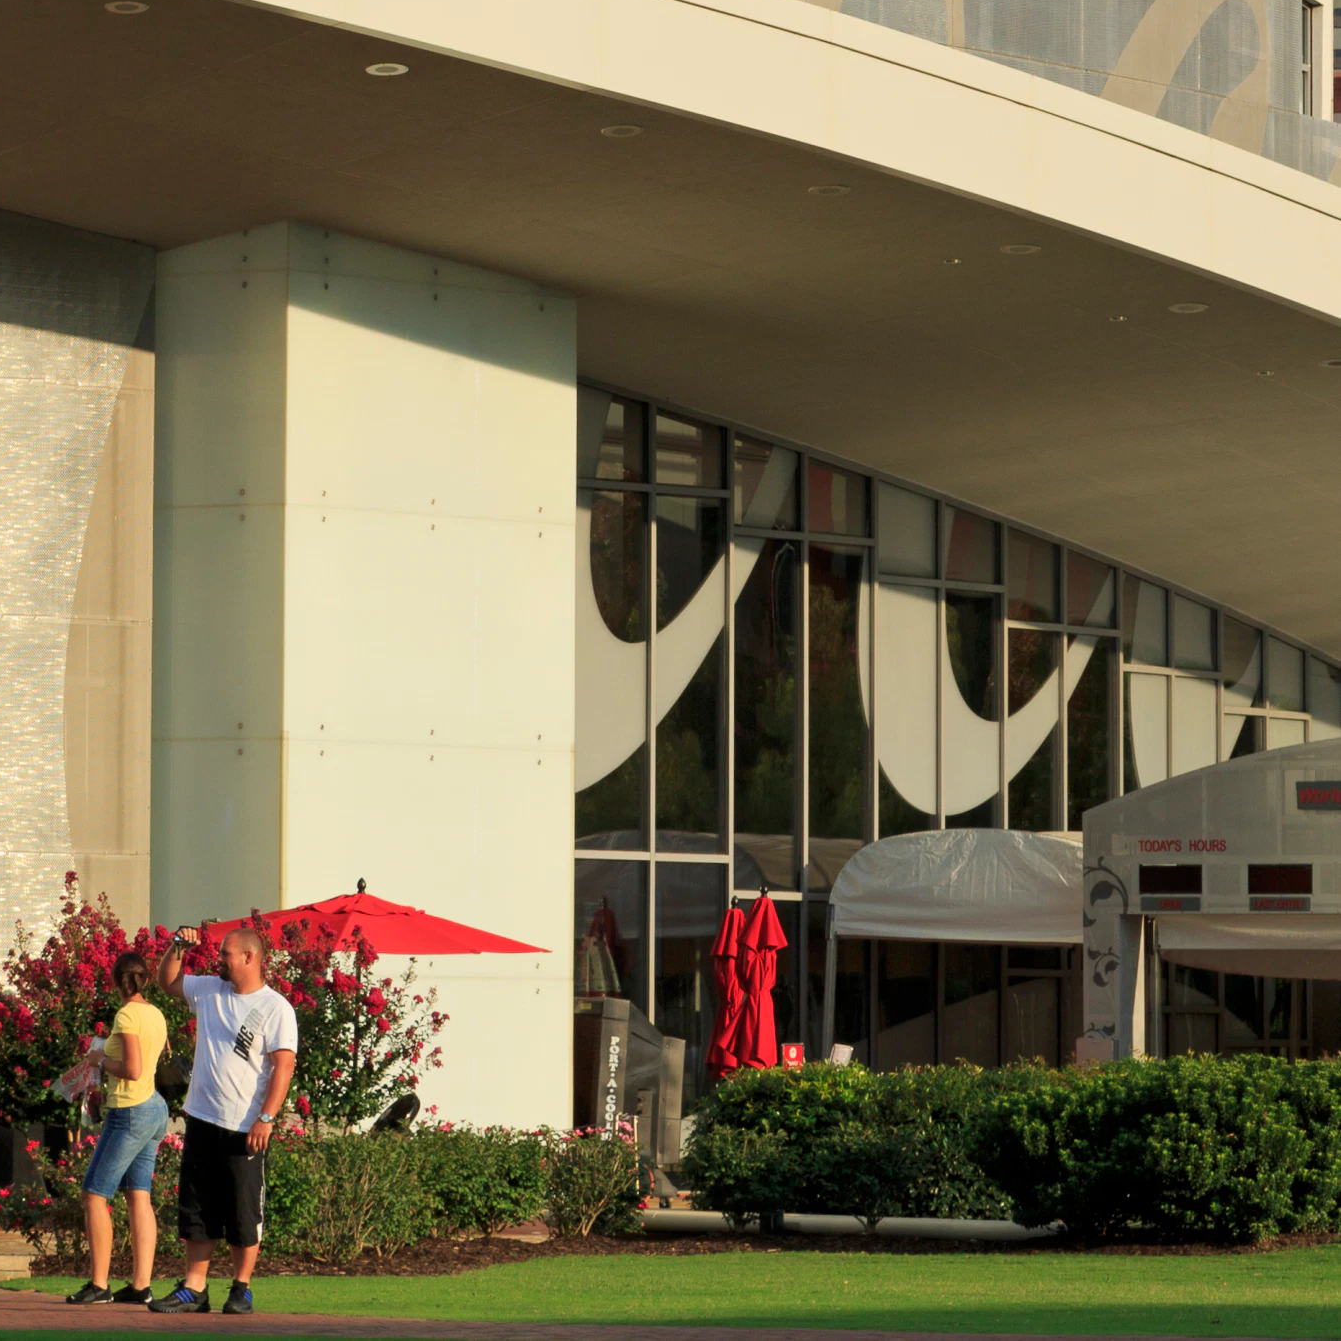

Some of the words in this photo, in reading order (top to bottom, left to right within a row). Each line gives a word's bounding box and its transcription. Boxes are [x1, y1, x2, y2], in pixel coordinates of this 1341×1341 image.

[1138, 839, 1182, 852] TODAY'S
[1189, 839, 1227, 852] HOURS
[1158, 899, 1183, 909] OPEN
[1275, 899, 1305, 908] ENTRY
